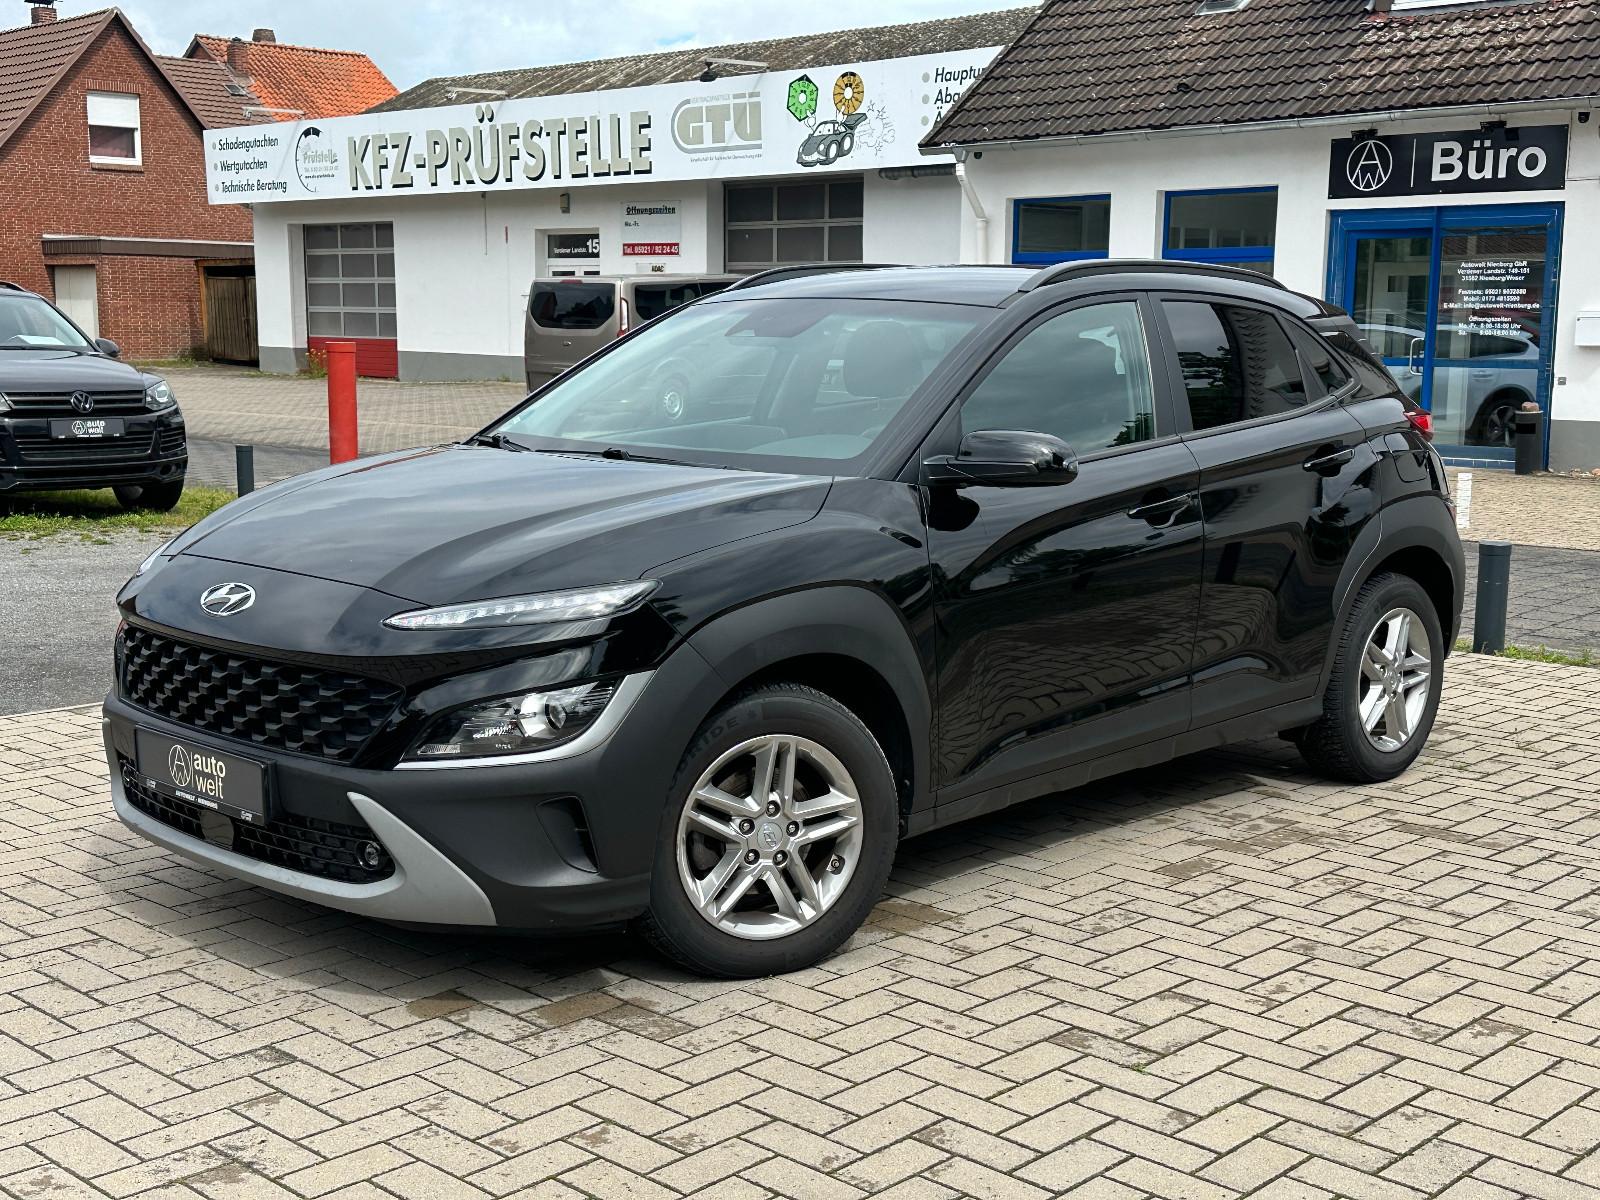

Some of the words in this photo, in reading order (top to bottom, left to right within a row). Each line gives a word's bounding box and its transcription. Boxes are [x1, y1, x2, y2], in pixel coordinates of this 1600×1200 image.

[676, 92, 762, 146] GTÜ
[218, 134, 278, 152] Schadengutachten
[347, 104, 652, 190] KFZ-PRÜFSTELLE
[220, 158, 267, 174] Wertgutachten
[1431, 139, 1547, 182] Büro
[221, 178, 255, 193] Technische
[256, 176, 287, 193] Beratung
[626, 204, 676, 215] Öffnungszeiten
[193, 753, 226, 778] auto
[195, 774, 224, 800] welt
